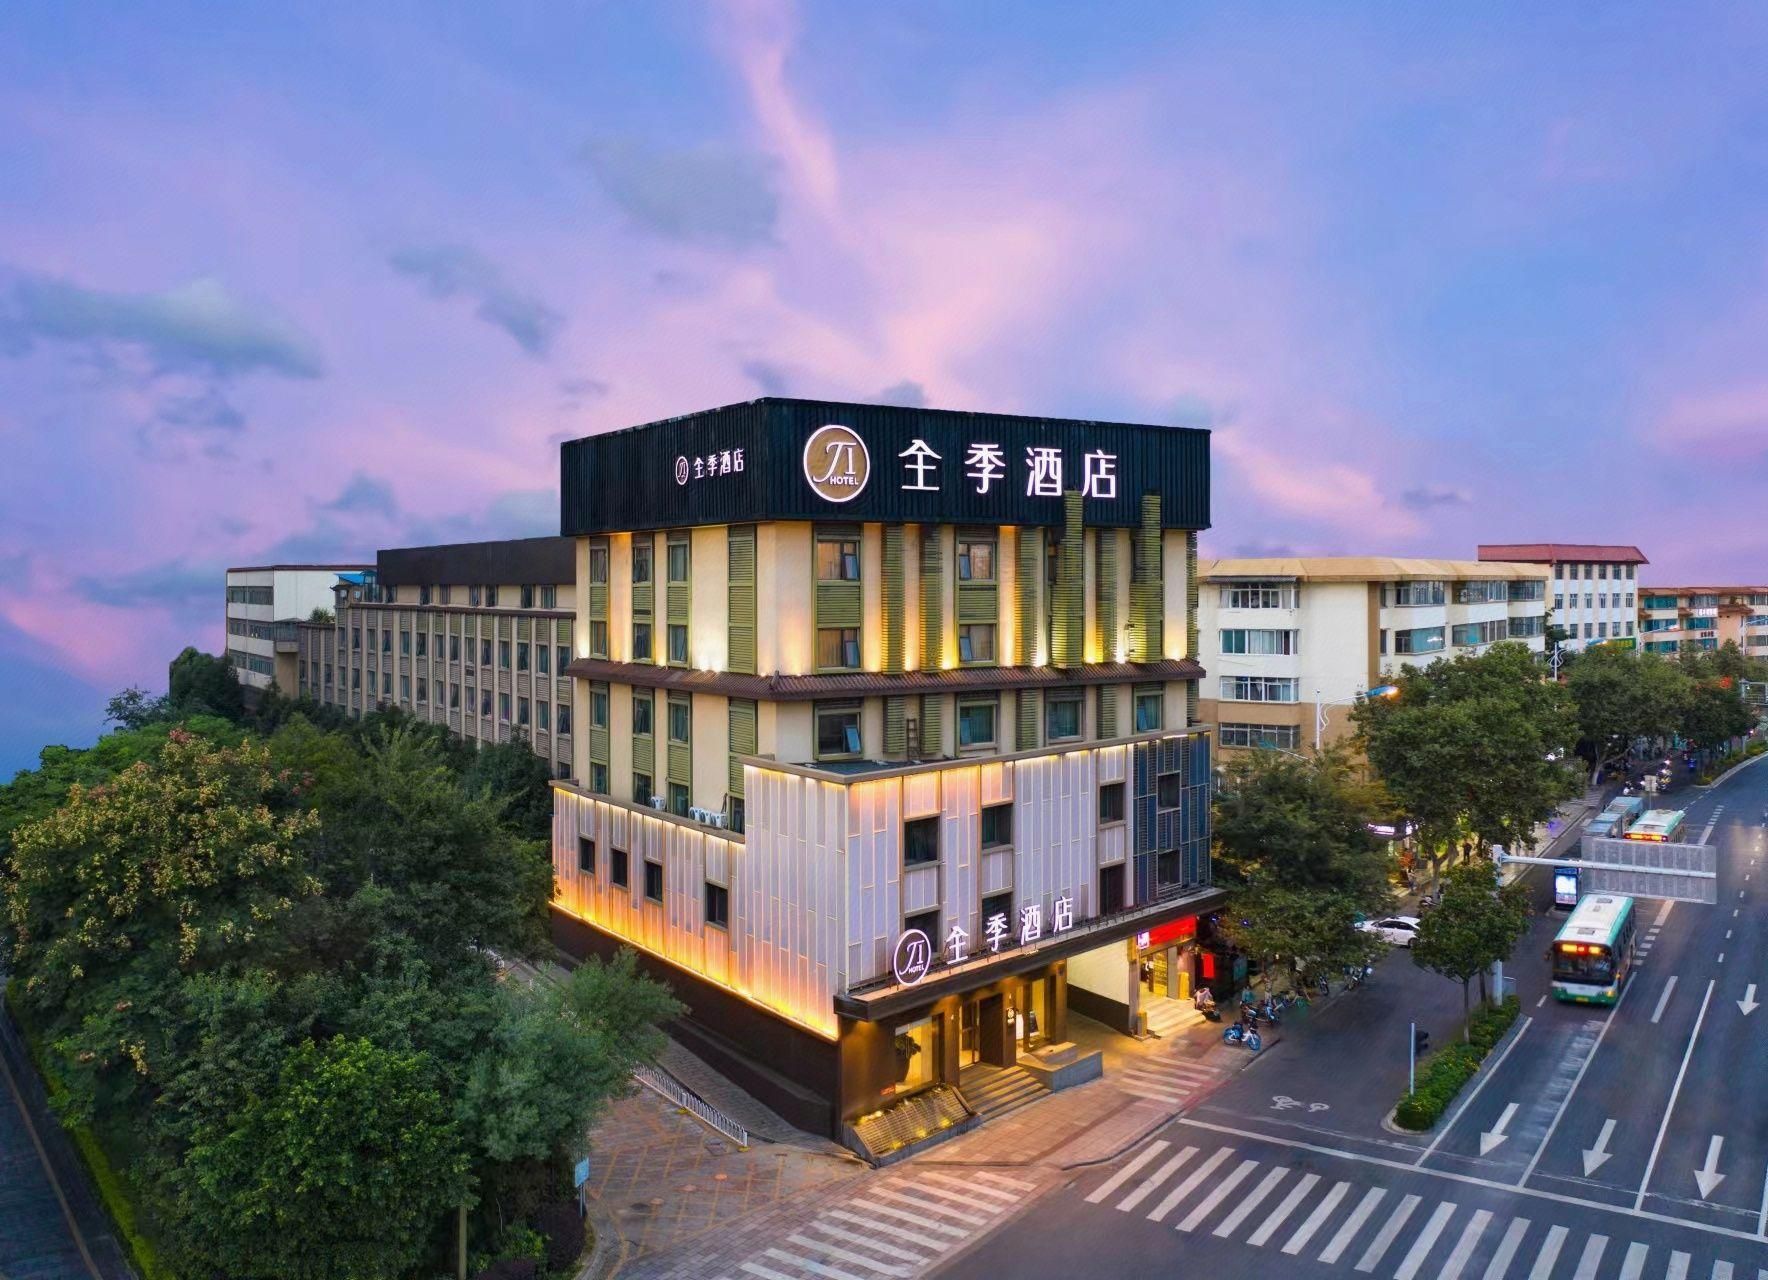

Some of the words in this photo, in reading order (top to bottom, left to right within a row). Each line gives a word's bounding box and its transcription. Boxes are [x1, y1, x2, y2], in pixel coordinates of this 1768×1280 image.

[693, 448, 744, 479] 全季酒店
[898, 439, 1117, 498] 全季酒店
[829, 475, 859, 485] HOTEL
[945, 896, 1073, 965] 全季酒店
[908, 964, 925, 974] HOTEL
